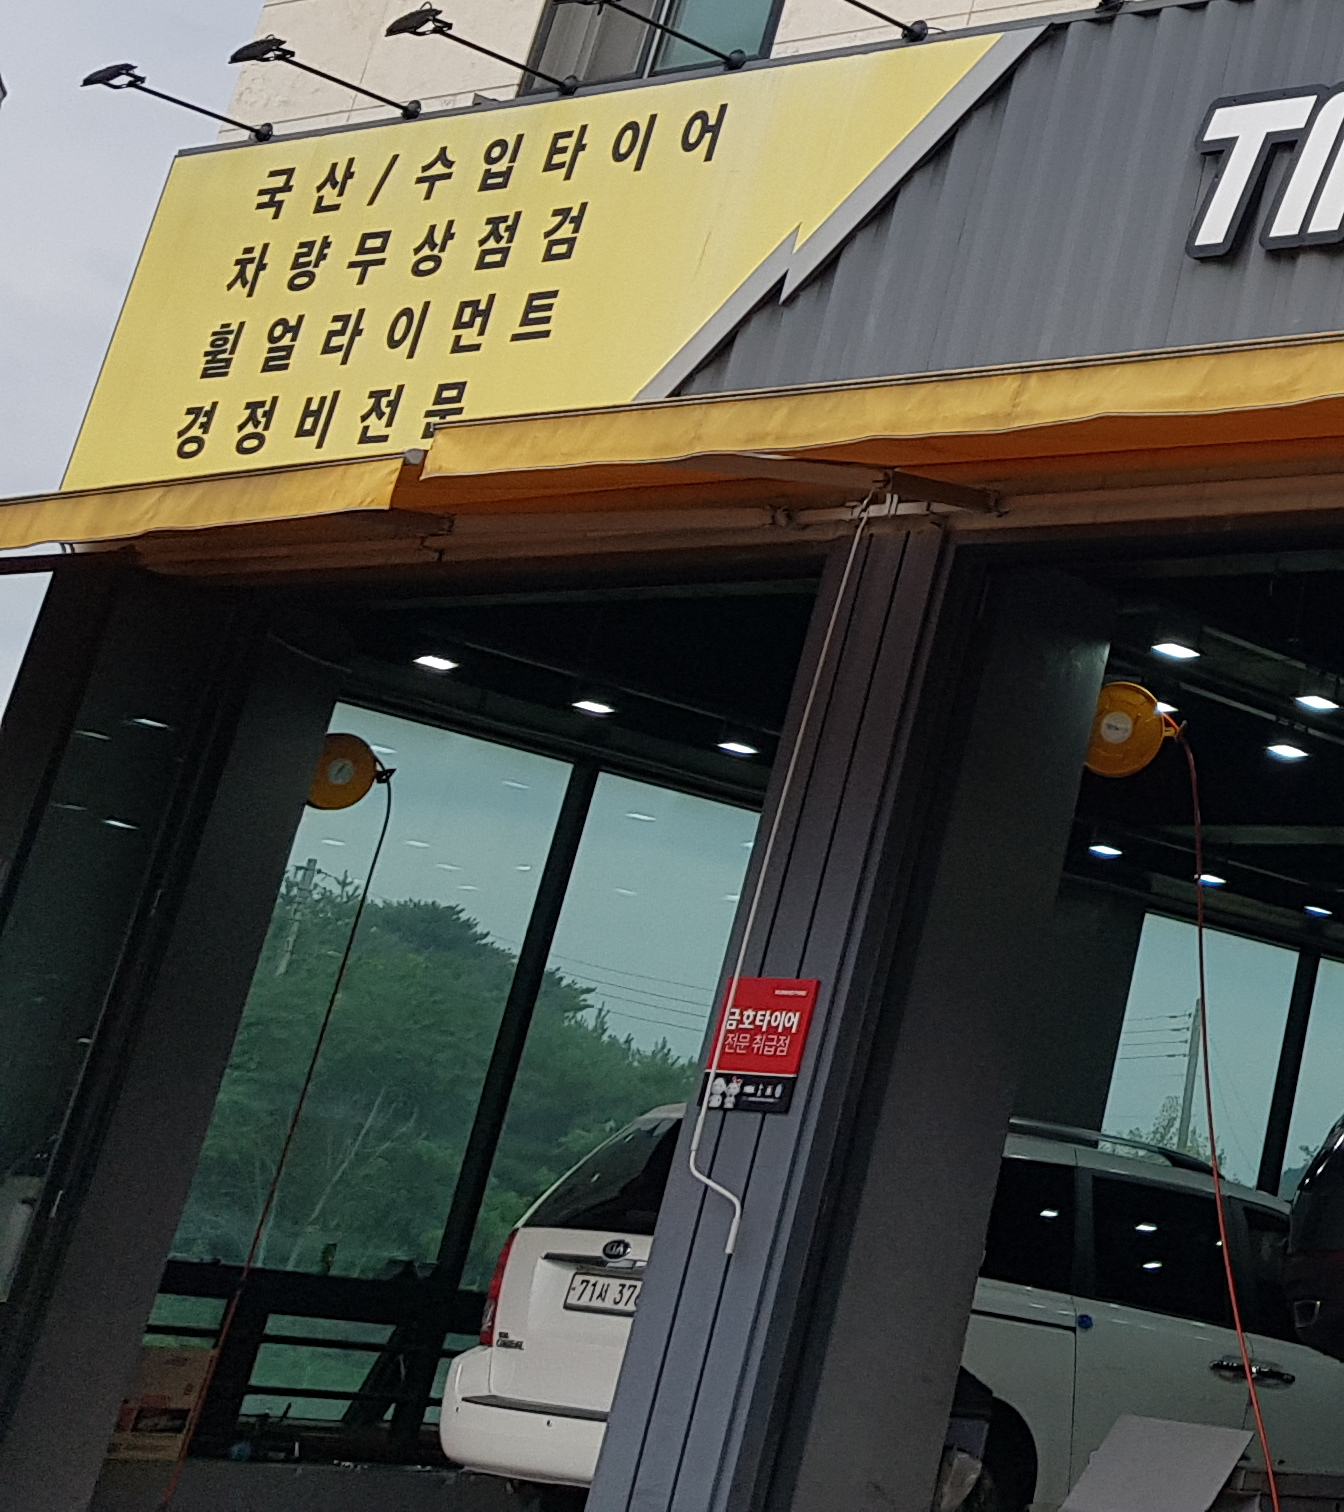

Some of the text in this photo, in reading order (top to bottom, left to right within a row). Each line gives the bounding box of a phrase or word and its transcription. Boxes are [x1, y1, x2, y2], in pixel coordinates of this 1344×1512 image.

[226, 201, 589, 298] 차량무상점검
[199, 289, 560, 380] 휠얼라이먼트
[724, 1032, 790, 1056] 전문 취급점
[726, 1008, 801, 1034] 금호타이어
